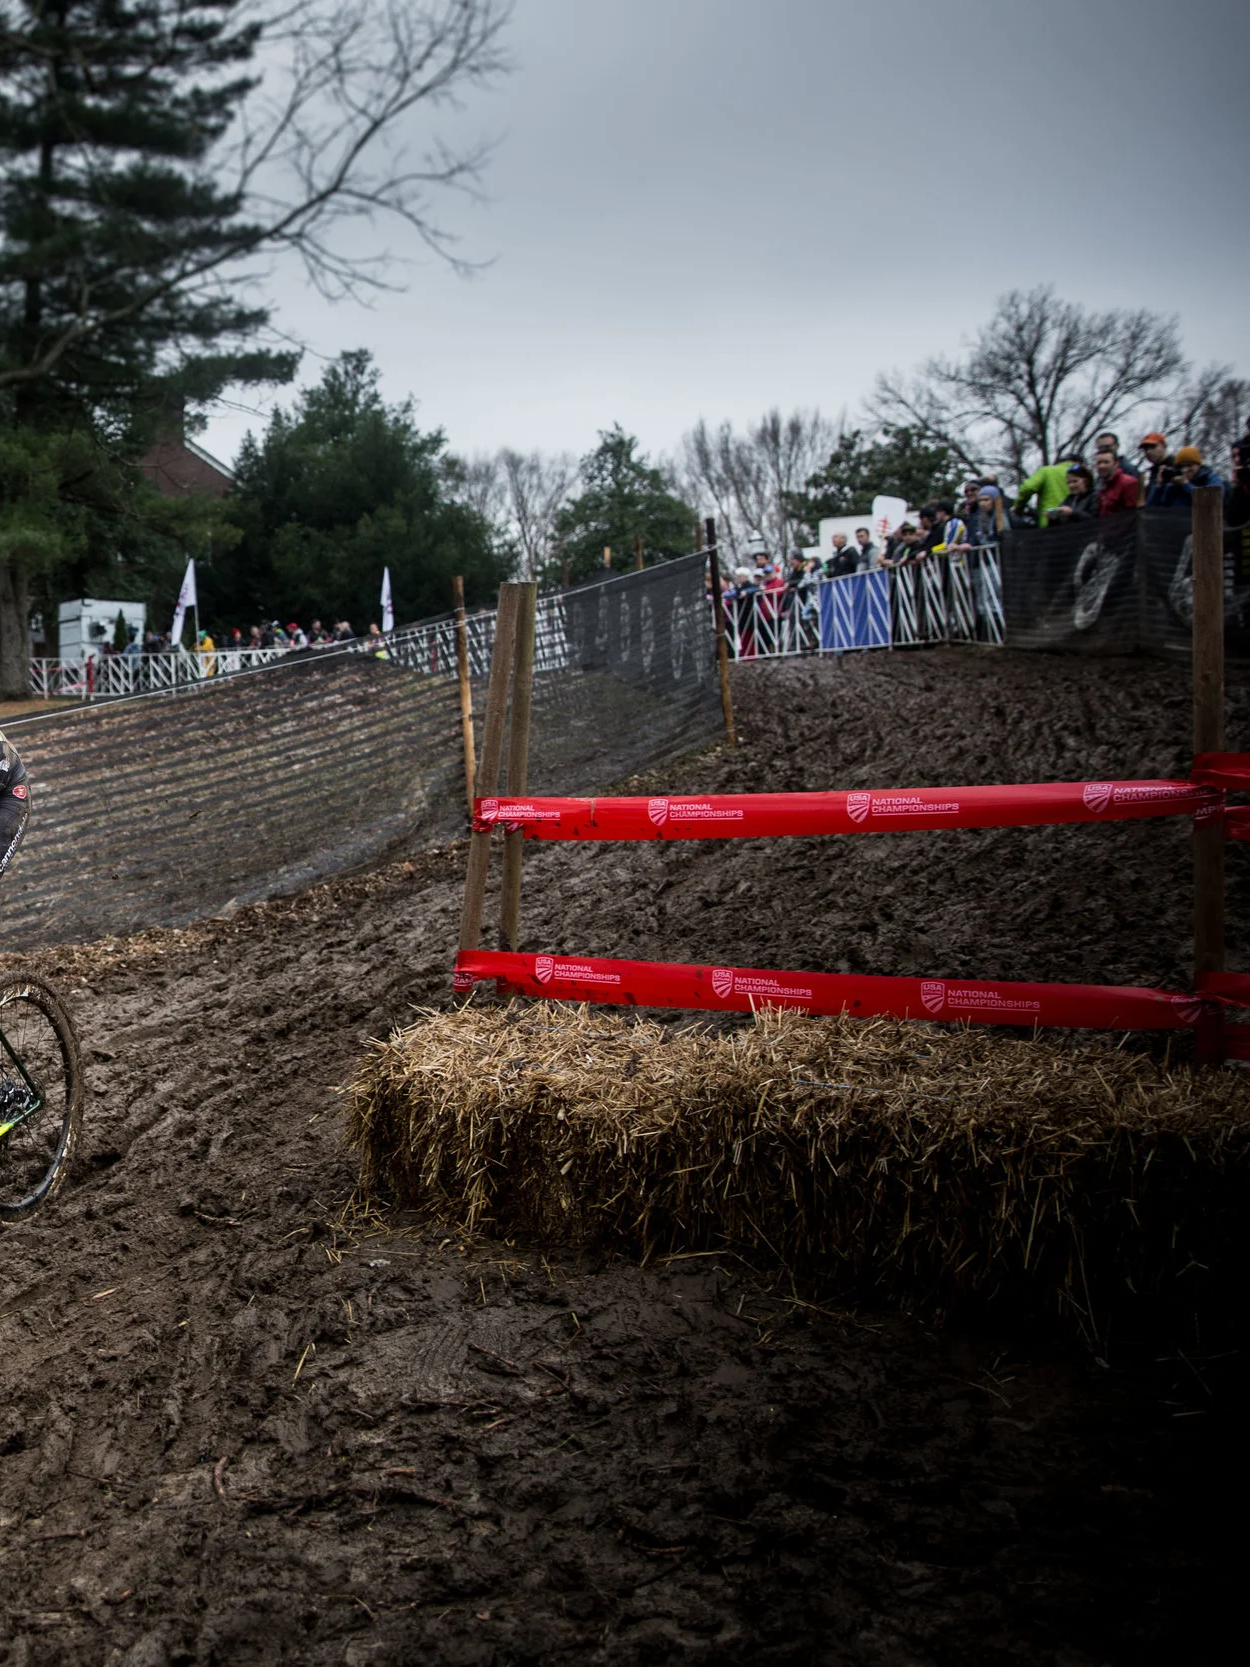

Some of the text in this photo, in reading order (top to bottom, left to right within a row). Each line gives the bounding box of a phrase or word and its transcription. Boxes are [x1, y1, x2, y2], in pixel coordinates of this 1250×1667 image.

[1086, 784, 1109, 792] USA
[850, 794, 868, 802] USA
[872, 797, 923, 805] NATIONAL
[871, 803, 960, 813] CHAMPIONSHIPS
[669, 810, 744, 818] CHAMPIONSHIPS
[554, 963, 594, 973] NATIONAL
[554, 970, 621, 982] CHAMPIONSHIPS
[734, 977, 780, 987] NATIONAL
[734, 984, 813, 996] CHAMPIONSHIPS
[947, 989, 1002, 999] NATIONAL
[947, 997, 1041, 1009] CHAMPIONSHIPS
